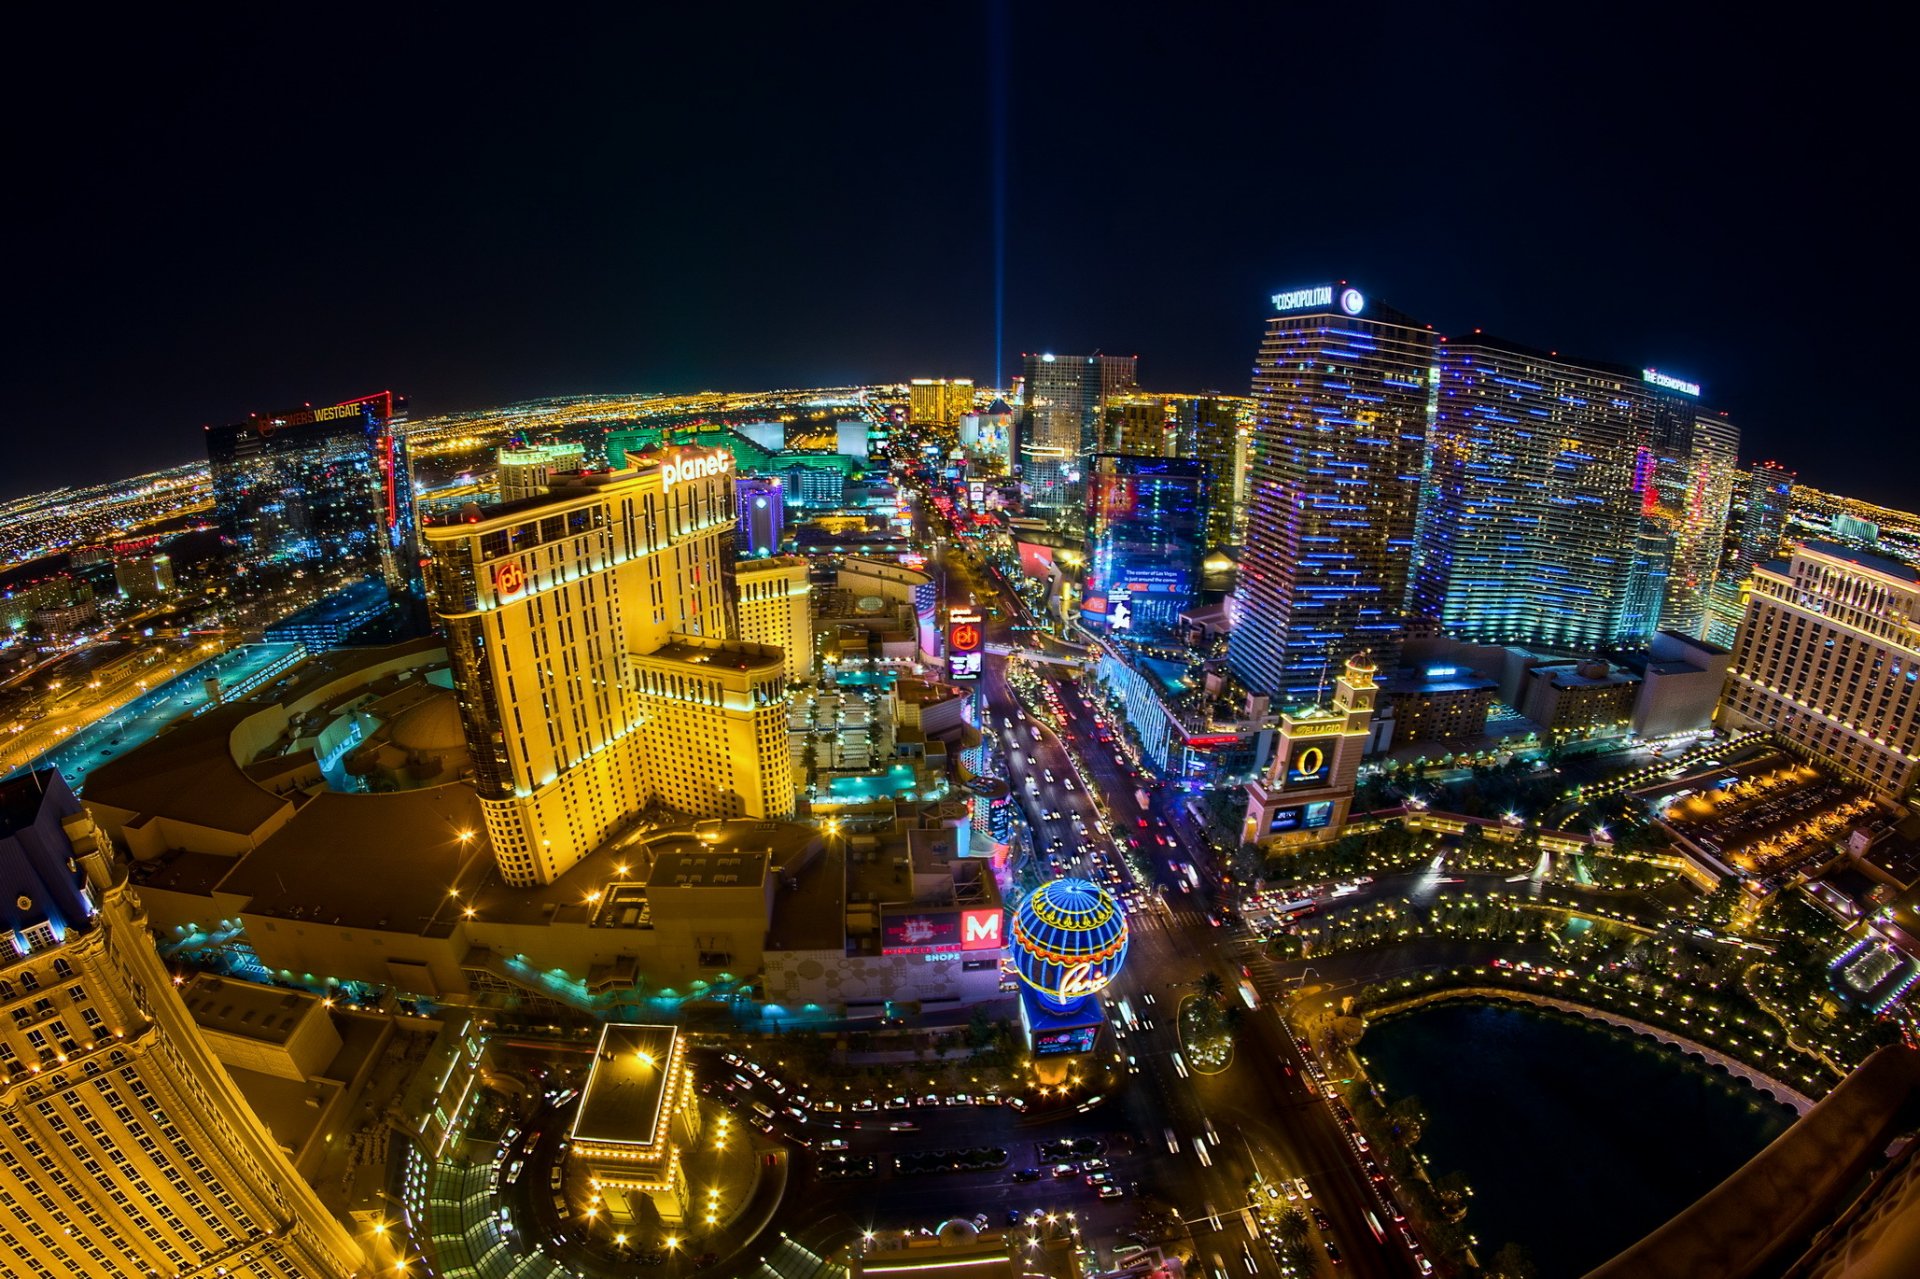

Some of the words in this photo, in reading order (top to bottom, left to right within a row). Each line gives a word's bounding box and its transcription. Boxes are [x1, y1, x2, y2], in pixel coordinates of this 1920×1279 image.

[1277, 287, 1331, 310] COSMOPOLITAN
[1643, 370, 1656, 383] THE
[1657, 374, 1699, 396] COSMOPOLITAN
[314, 403, 360, 422] WESTGATE
[662, 449, 729, 494] planet
[501, 564, 522, 593] ph
[1297, 748, 1323, 776] O
[967, 914, 998, 941] M
[924, 953, 959, 961] SHOPS
[1060, 963, 1107, 1005] Paris
